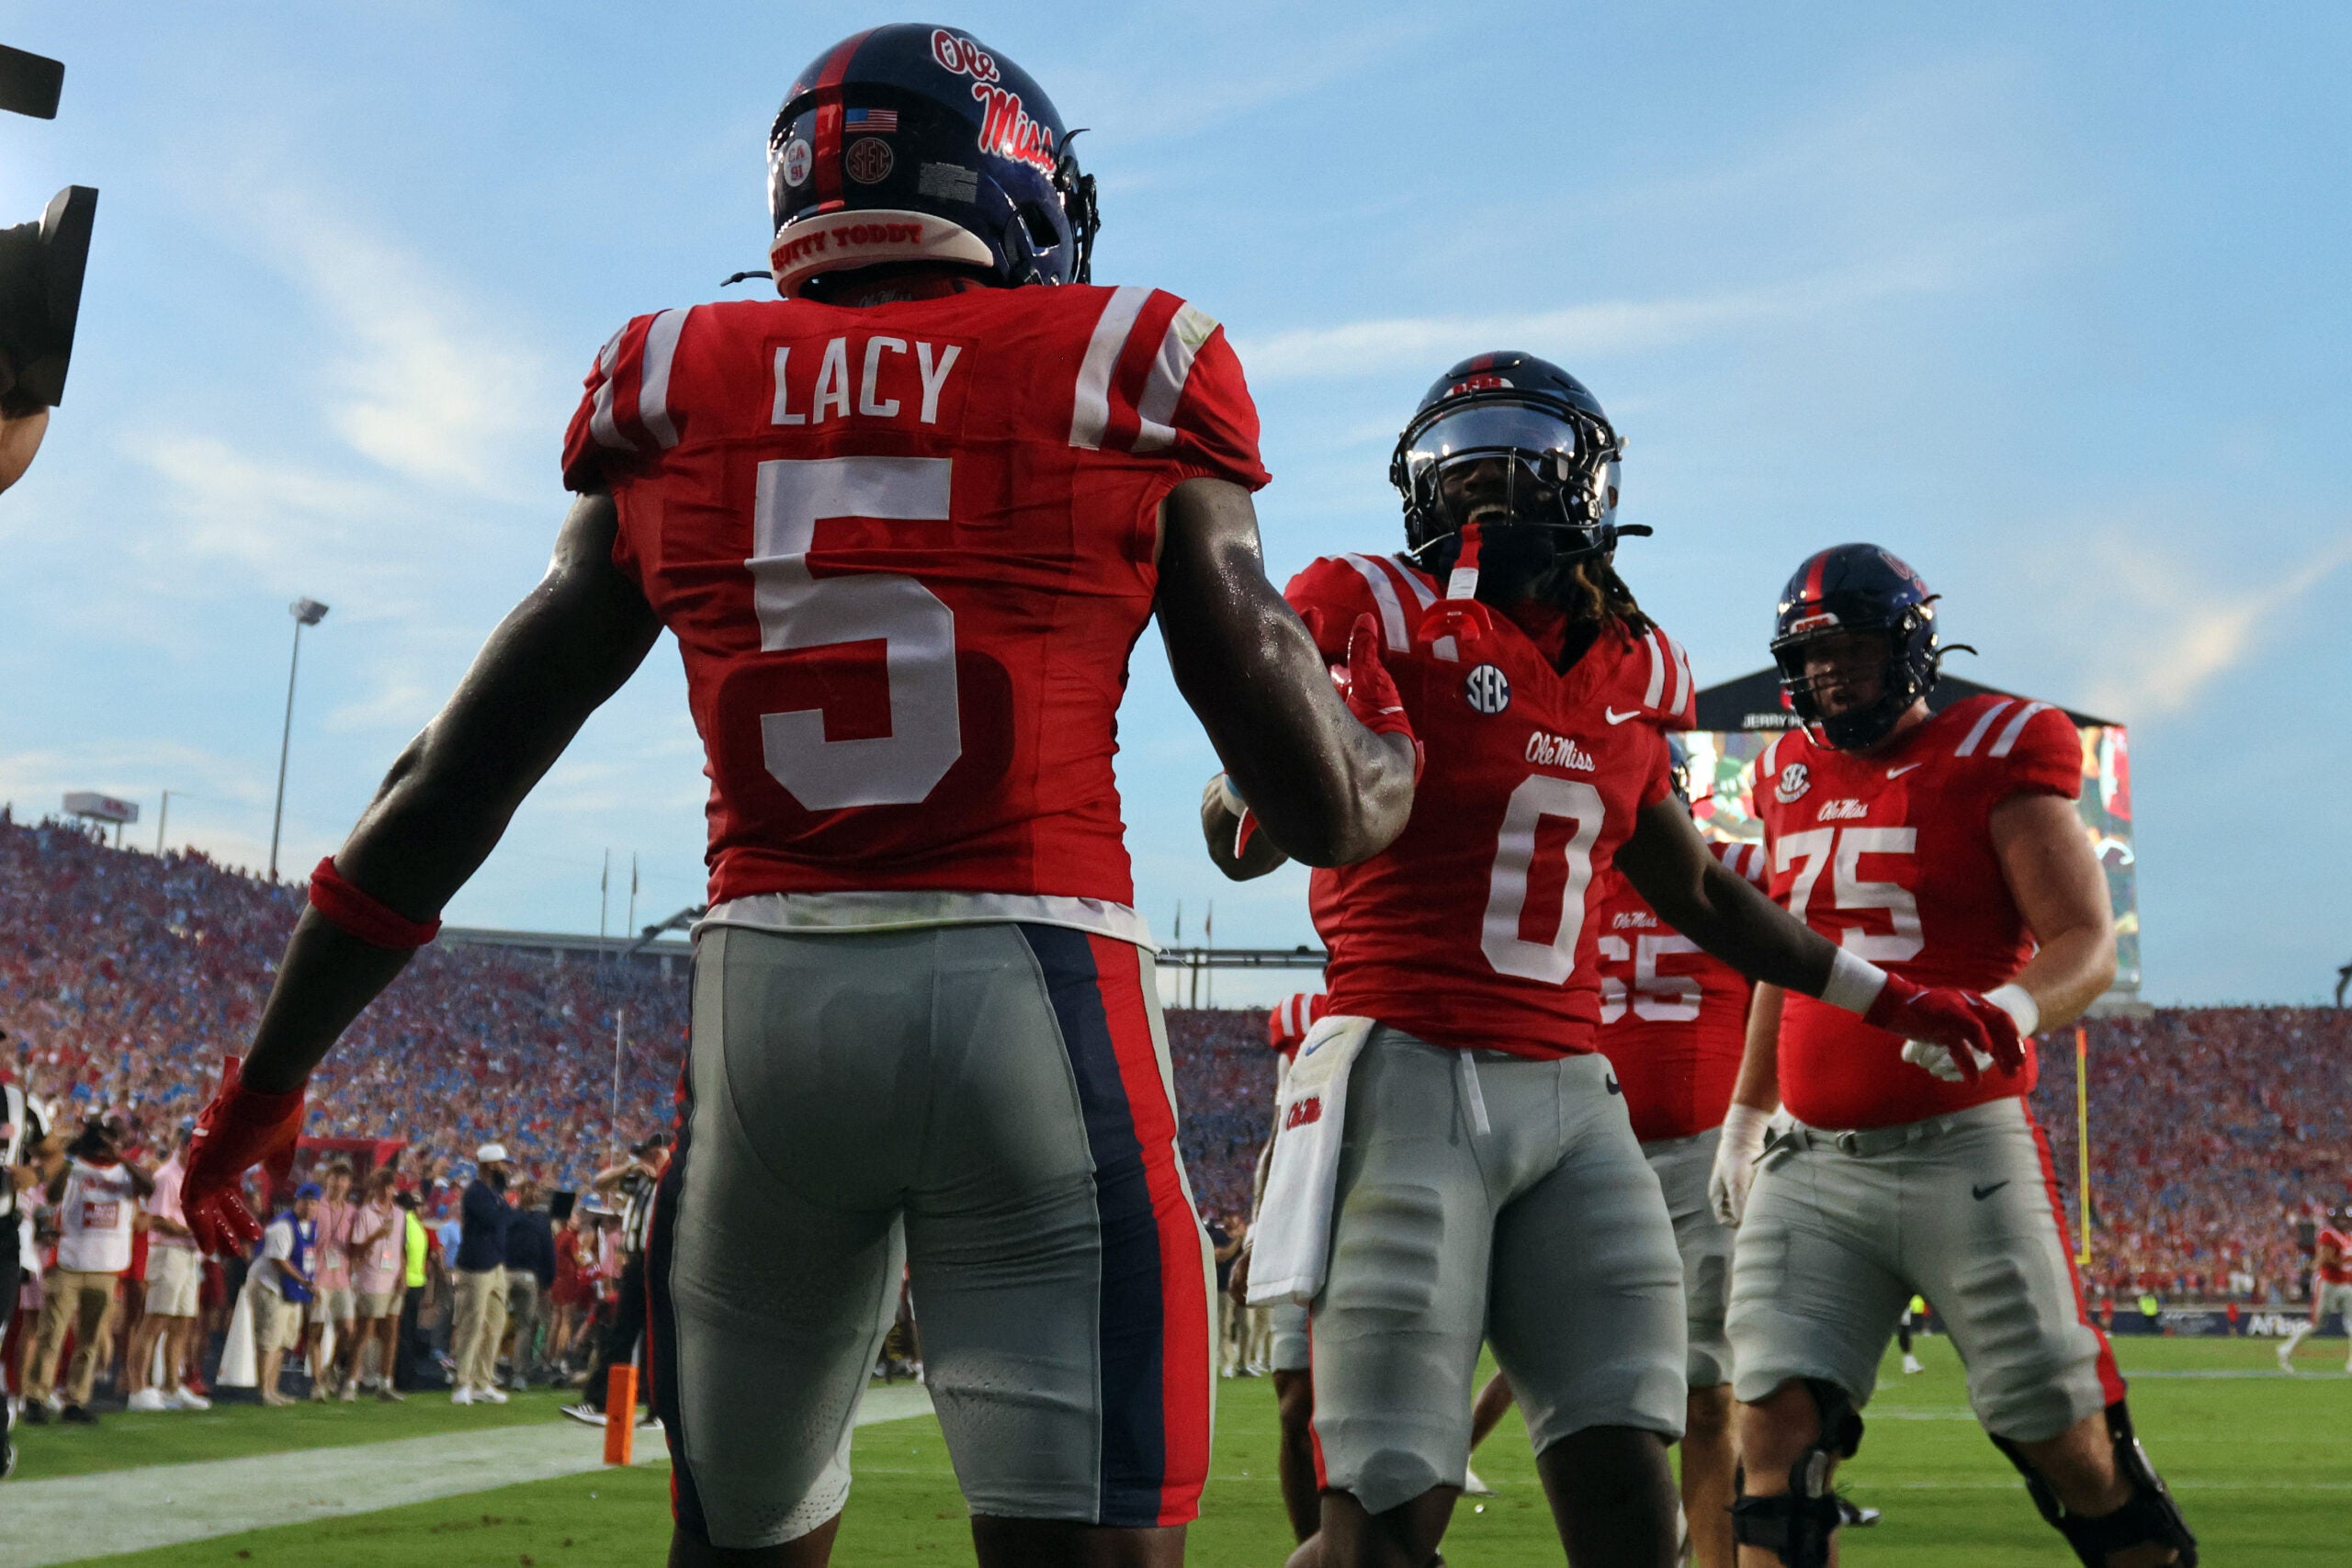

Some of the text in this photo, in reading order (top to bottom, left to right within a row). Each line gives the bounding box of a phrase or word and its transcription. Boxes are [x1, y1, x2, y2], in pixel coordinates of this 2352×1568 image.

[931, 29, 1000, 82] Ole
[971, 82, 1057, 174] Miss
[848, 138, 892, 182] SEC
[831, 223, 923, 246] TODDY
[771, 335, 962, 424] LACY
[744, 456, 963, 811] 5
[1466, 664, 1509, 714] SEC
[1742, 714, 1787, 728] JERRY
[1525, 731, 1595, 772] Ole Miss
[1781, 762, 1808, 793] SEC
[1481, 774, 1606, 985] 0
[1776, 828, 1925, 961] 75
